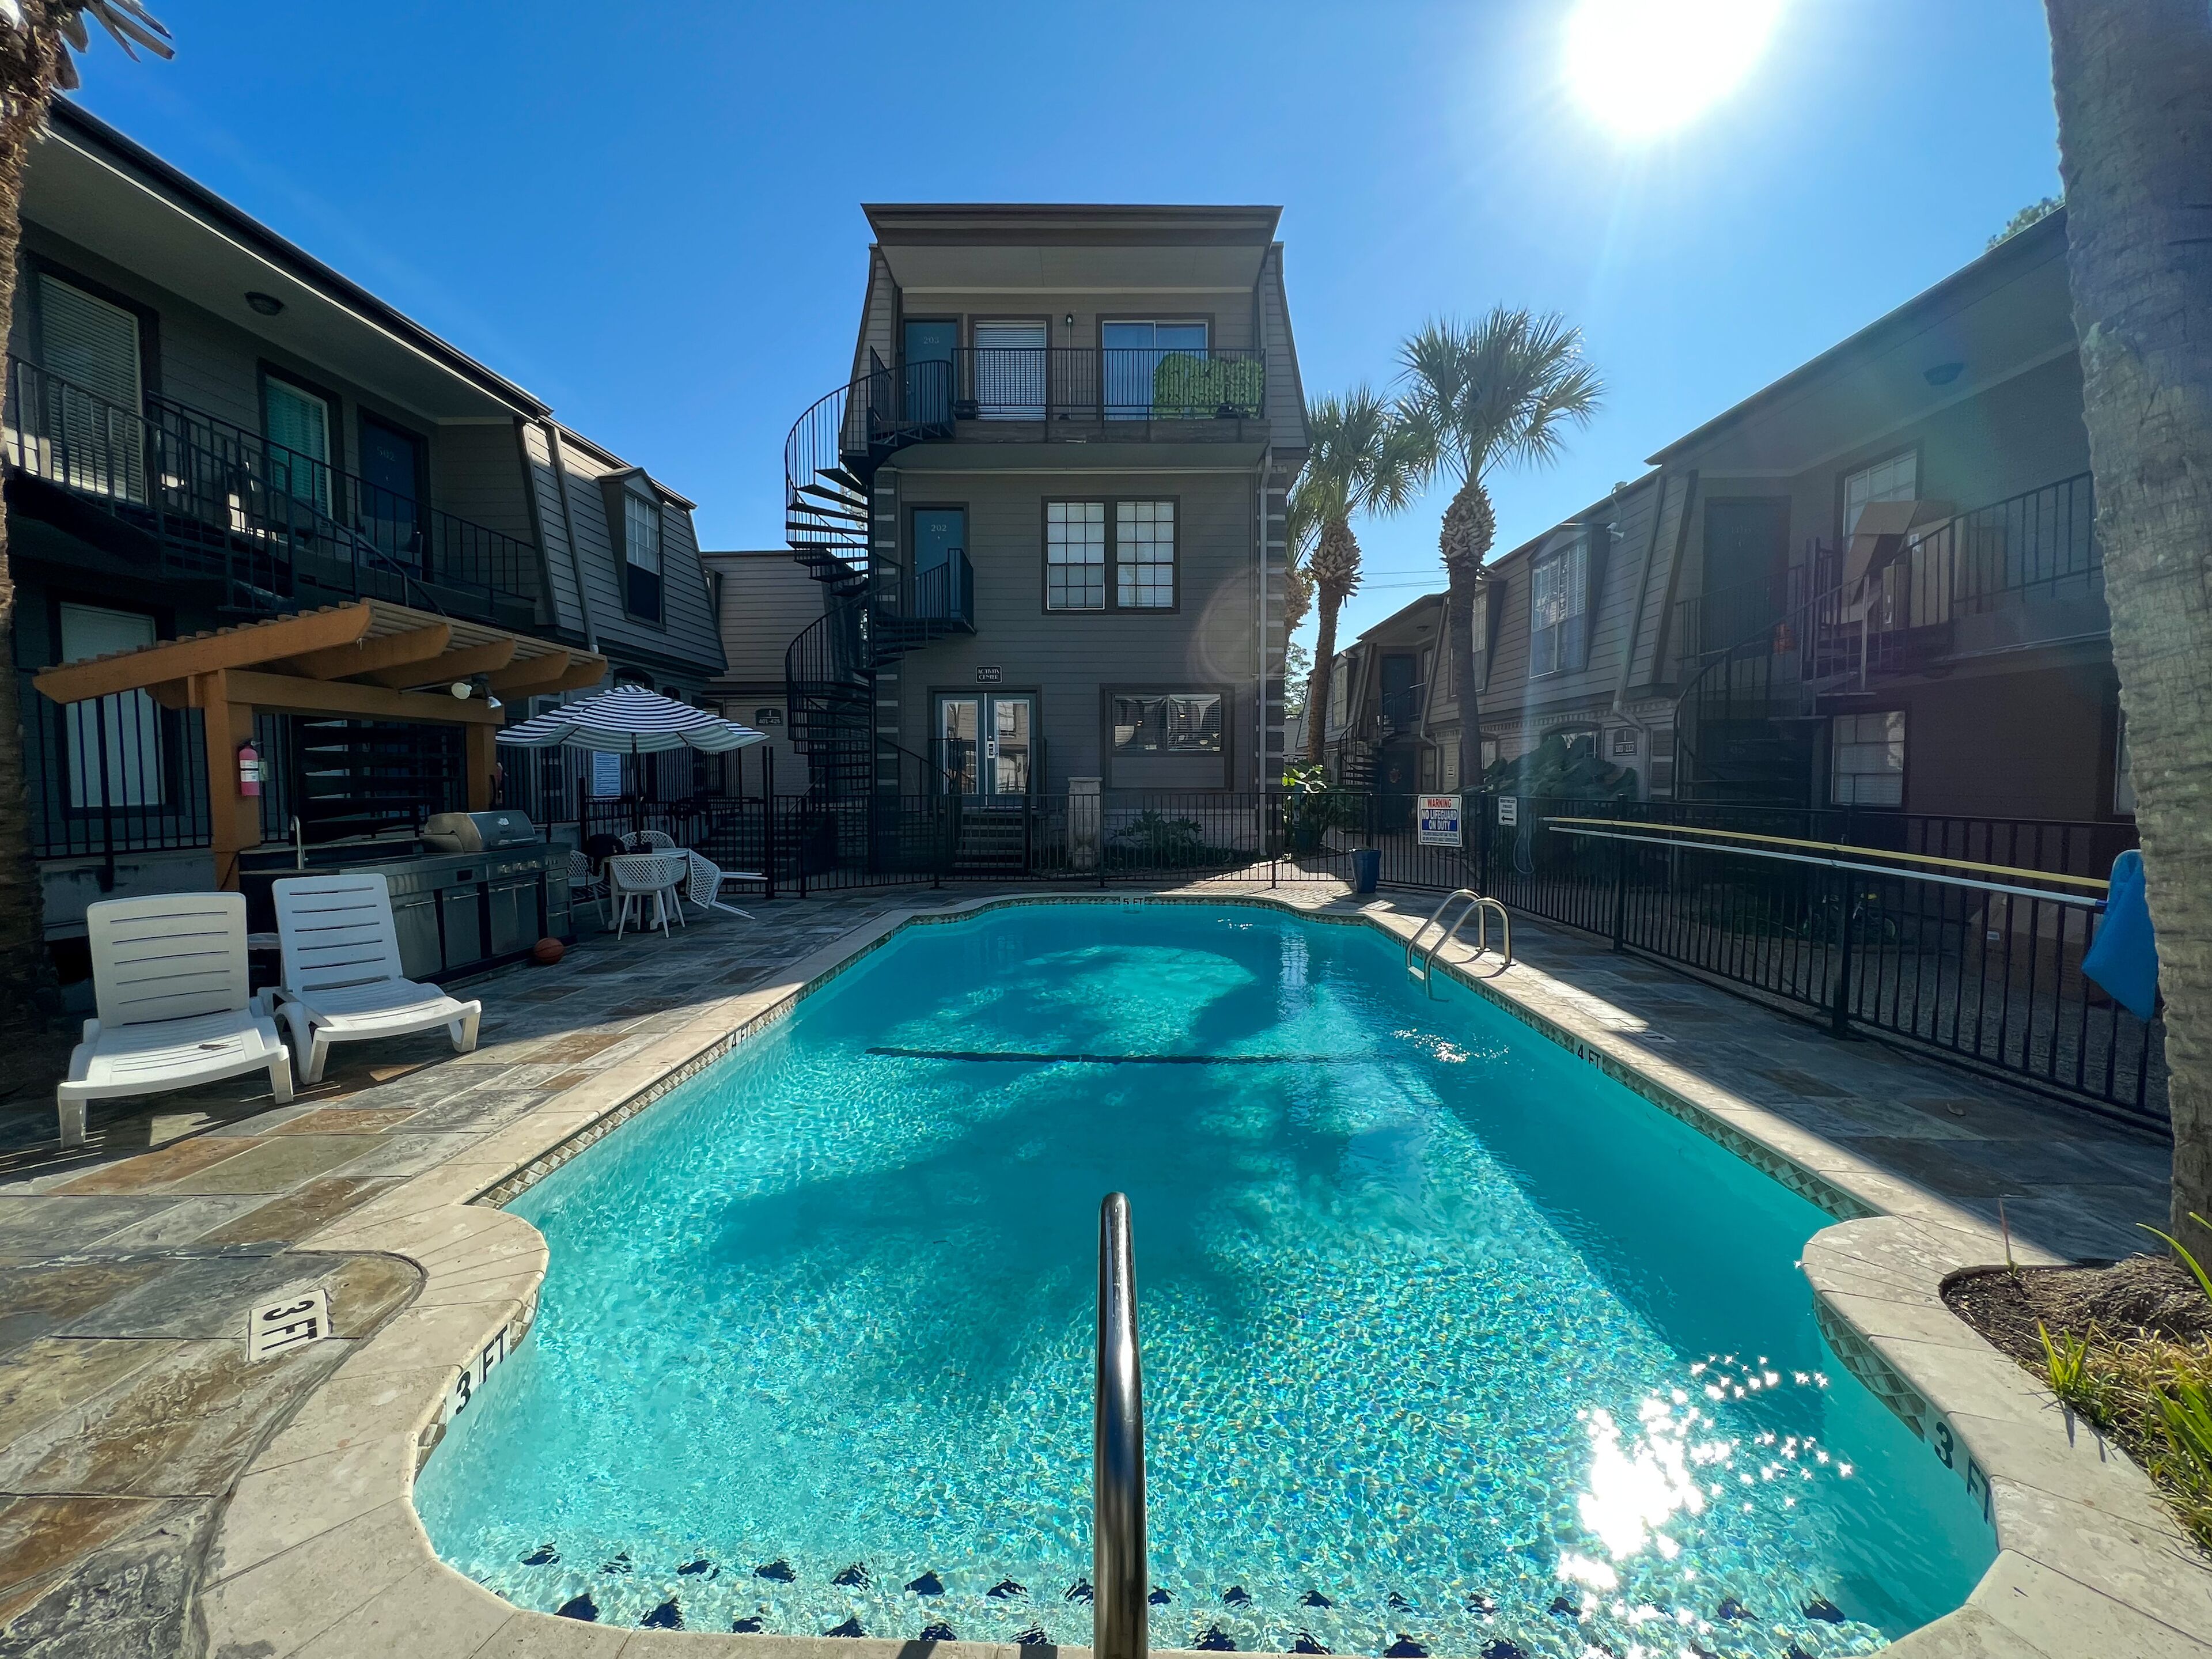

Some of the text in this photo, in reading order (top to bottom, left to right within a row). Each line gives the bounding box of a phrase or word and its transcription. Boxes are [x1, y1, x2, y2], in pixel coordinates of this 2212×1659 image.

[931, 524, 947, 532] 202
[1427, 798, 1451, 808] WARNING
[1422, 810, 1457, 820] NO LIFEGUARD
[1429, 820, 1450, 831] ON DUTY
[732, 1032, 737, 1048] 4
[1577, 1044, 1601, 1069] 4 FT
[262, 1300, 317, 1350] 3 FT
[456, 1324, 507, 1415] 3 FT
[1934, 1421, 1992, 1525] 3 FT
